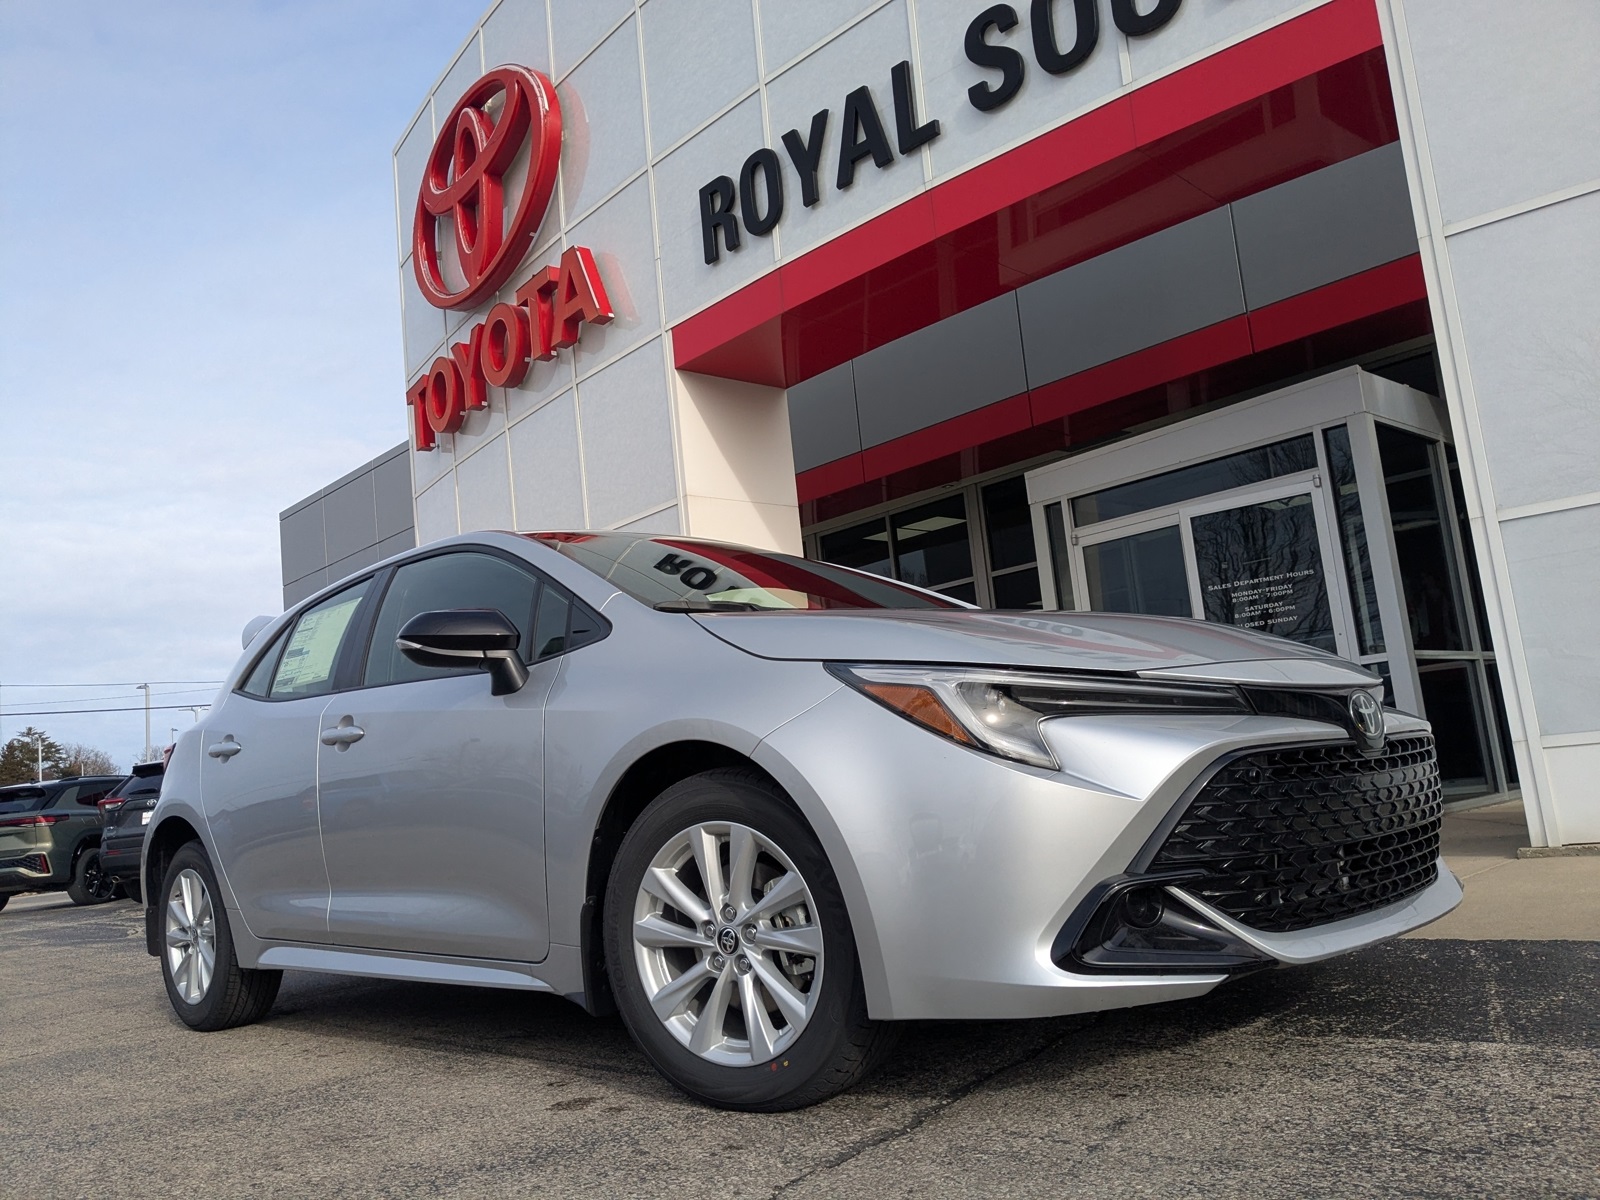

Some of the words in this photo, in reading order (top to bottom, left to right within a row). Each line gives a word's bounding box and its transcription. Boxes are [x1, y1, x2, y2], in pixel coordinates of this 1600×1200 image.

[699, 60, 940, 265] ROYAL
[406, 245, 615, 451] TOYOTA
[1234, 575, 1284, 587] DEPARTMENT
[1286, 569, 1315, 578] HOURS
[1231, 583, 1293, 598] MONDAY-FRIDAY
[1266, 589, 1294, 598] 7:00PM
[1244, 601, 1283, 611] SATURDAY
[1237, 620, 1265, 628] OSED
[1267, 615, 1298, 625] SUNDAY
